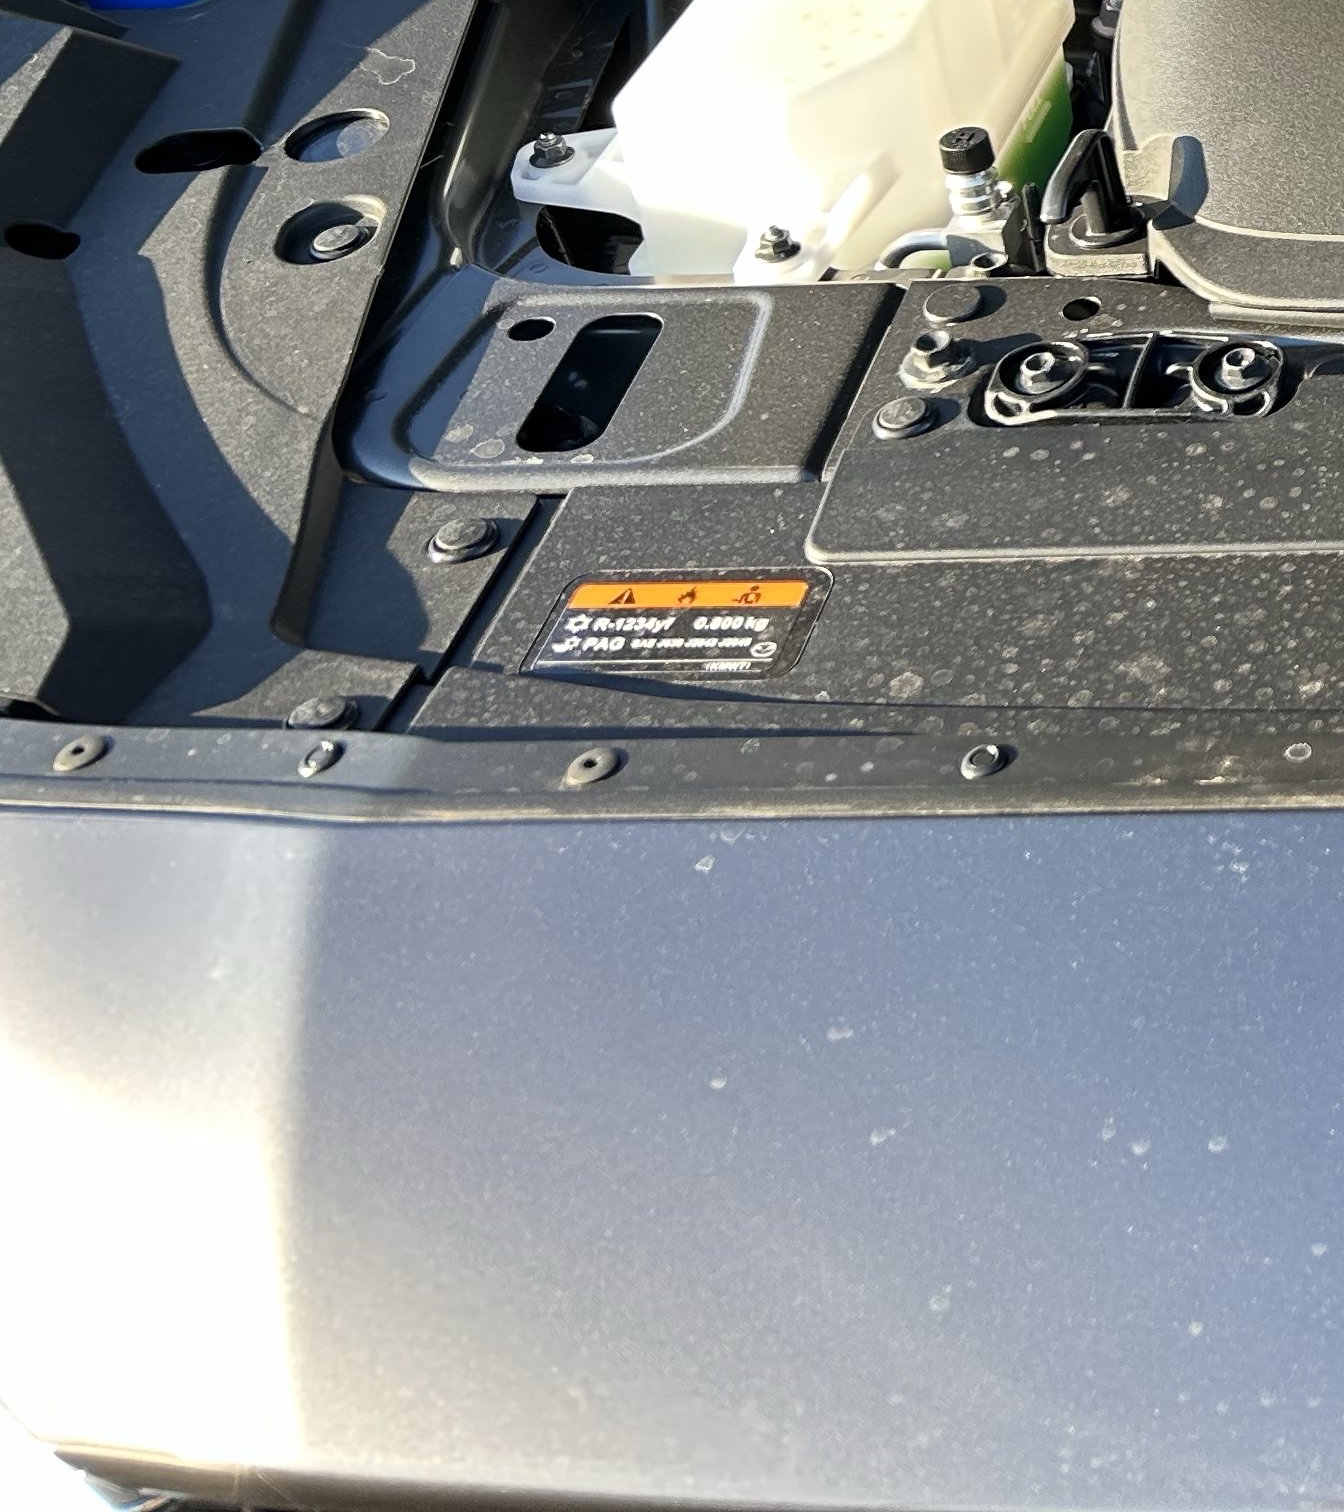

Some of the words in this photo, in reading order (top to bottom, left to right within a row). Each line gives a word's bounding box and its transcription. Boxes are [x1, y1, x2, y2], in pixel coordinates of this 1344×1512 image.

[593, 615, 677, 634] R-1234yf
[744, 616, 770, 632] kg
[582, 636, 626, 652] PAG
